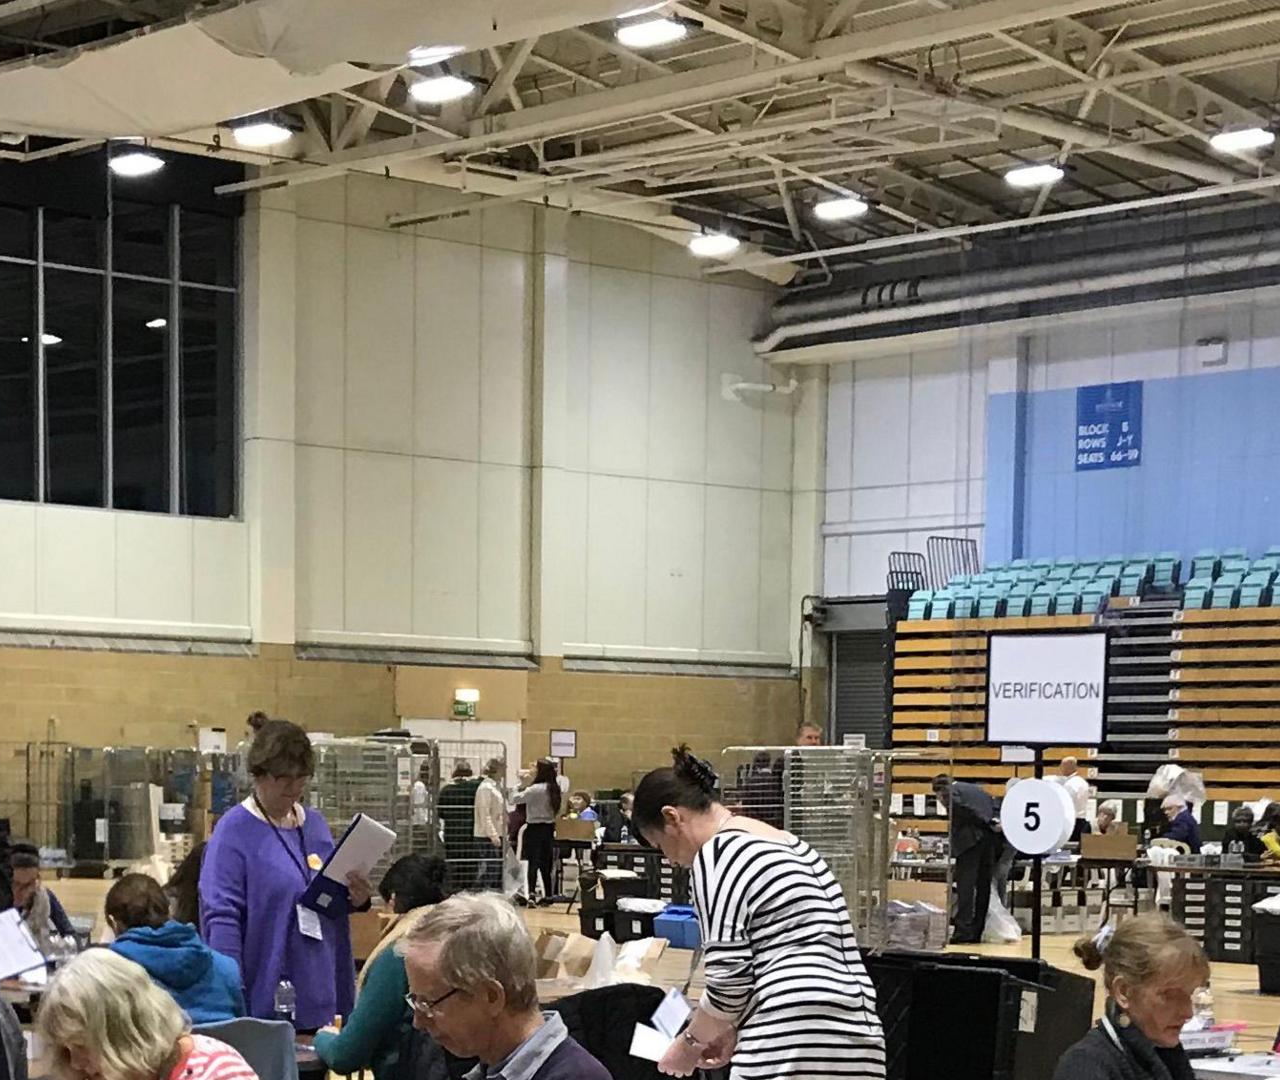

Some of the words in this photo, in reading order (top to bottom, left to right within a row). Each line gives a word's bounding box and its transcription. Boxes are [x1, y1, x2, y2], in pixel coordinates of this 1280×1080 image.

[1078, 423, 1109, 436] BLOCK
[1078, 437, 1106, 449] ROWS
[1077, 452, 1105, 465] SEATS
[992, 682, 1100, 700] VERIFICATION
[1024, 802, 1040, 832] 5
